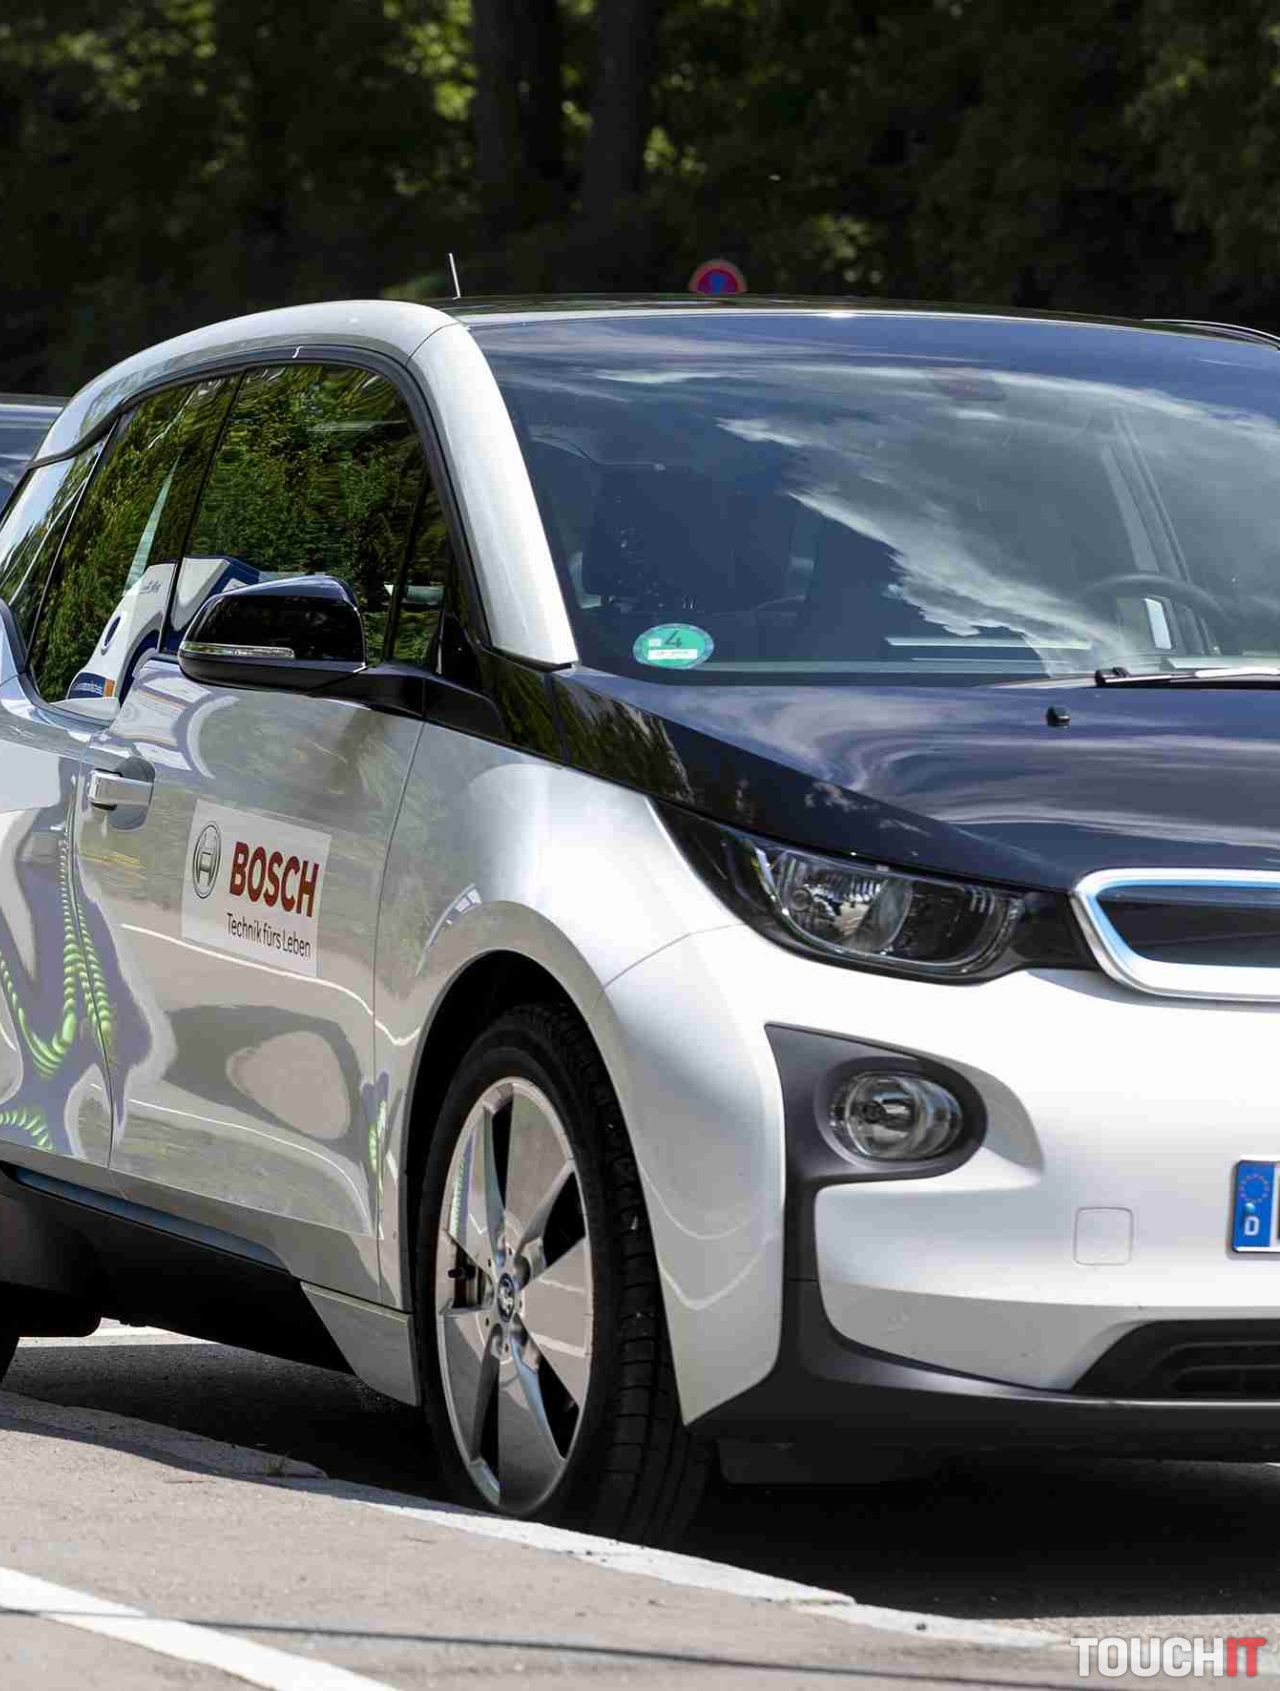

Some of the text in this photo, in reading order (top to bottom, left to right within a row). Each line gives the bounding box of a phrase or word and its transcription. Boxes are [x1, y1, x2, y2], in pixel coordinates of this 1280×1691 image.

[665, 629, 682, 648] 4
[229, 841, 320, 918] BOSCH
[226, 912, 311, 959] Technik fürs Leben
[1243, 1215, 1261, 1236] D
